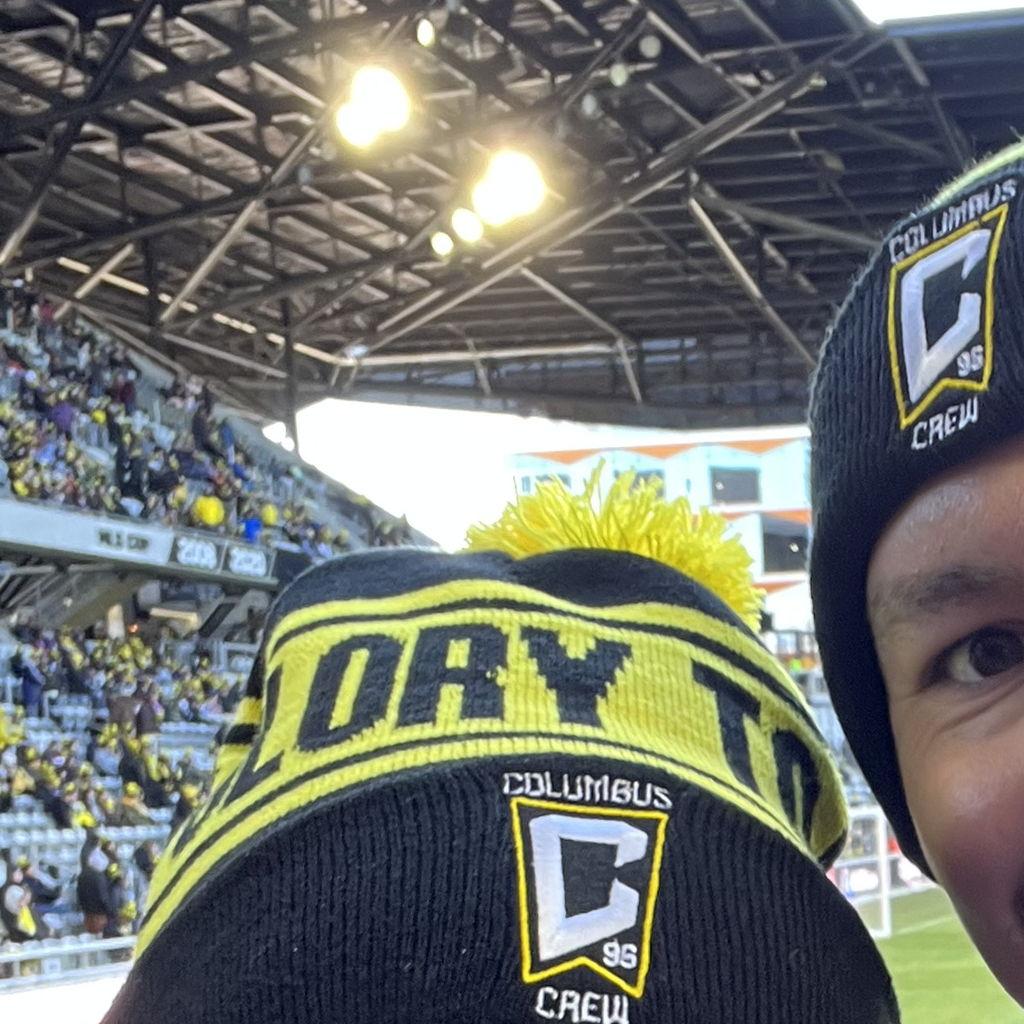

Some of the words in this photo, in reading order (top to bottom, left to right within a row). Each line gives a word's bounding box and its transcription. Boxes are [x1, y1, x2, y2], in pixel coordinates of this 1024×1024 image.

[888, 178, 1018, 265] COLUMBUS
[900, 228, 993, 404] C
[910, 395, 980, 451] CREW
[502, 770, 674, 810] COLUMBUS
[528, 813, 650, 963] C
[602, 938, 639, 970] 96
